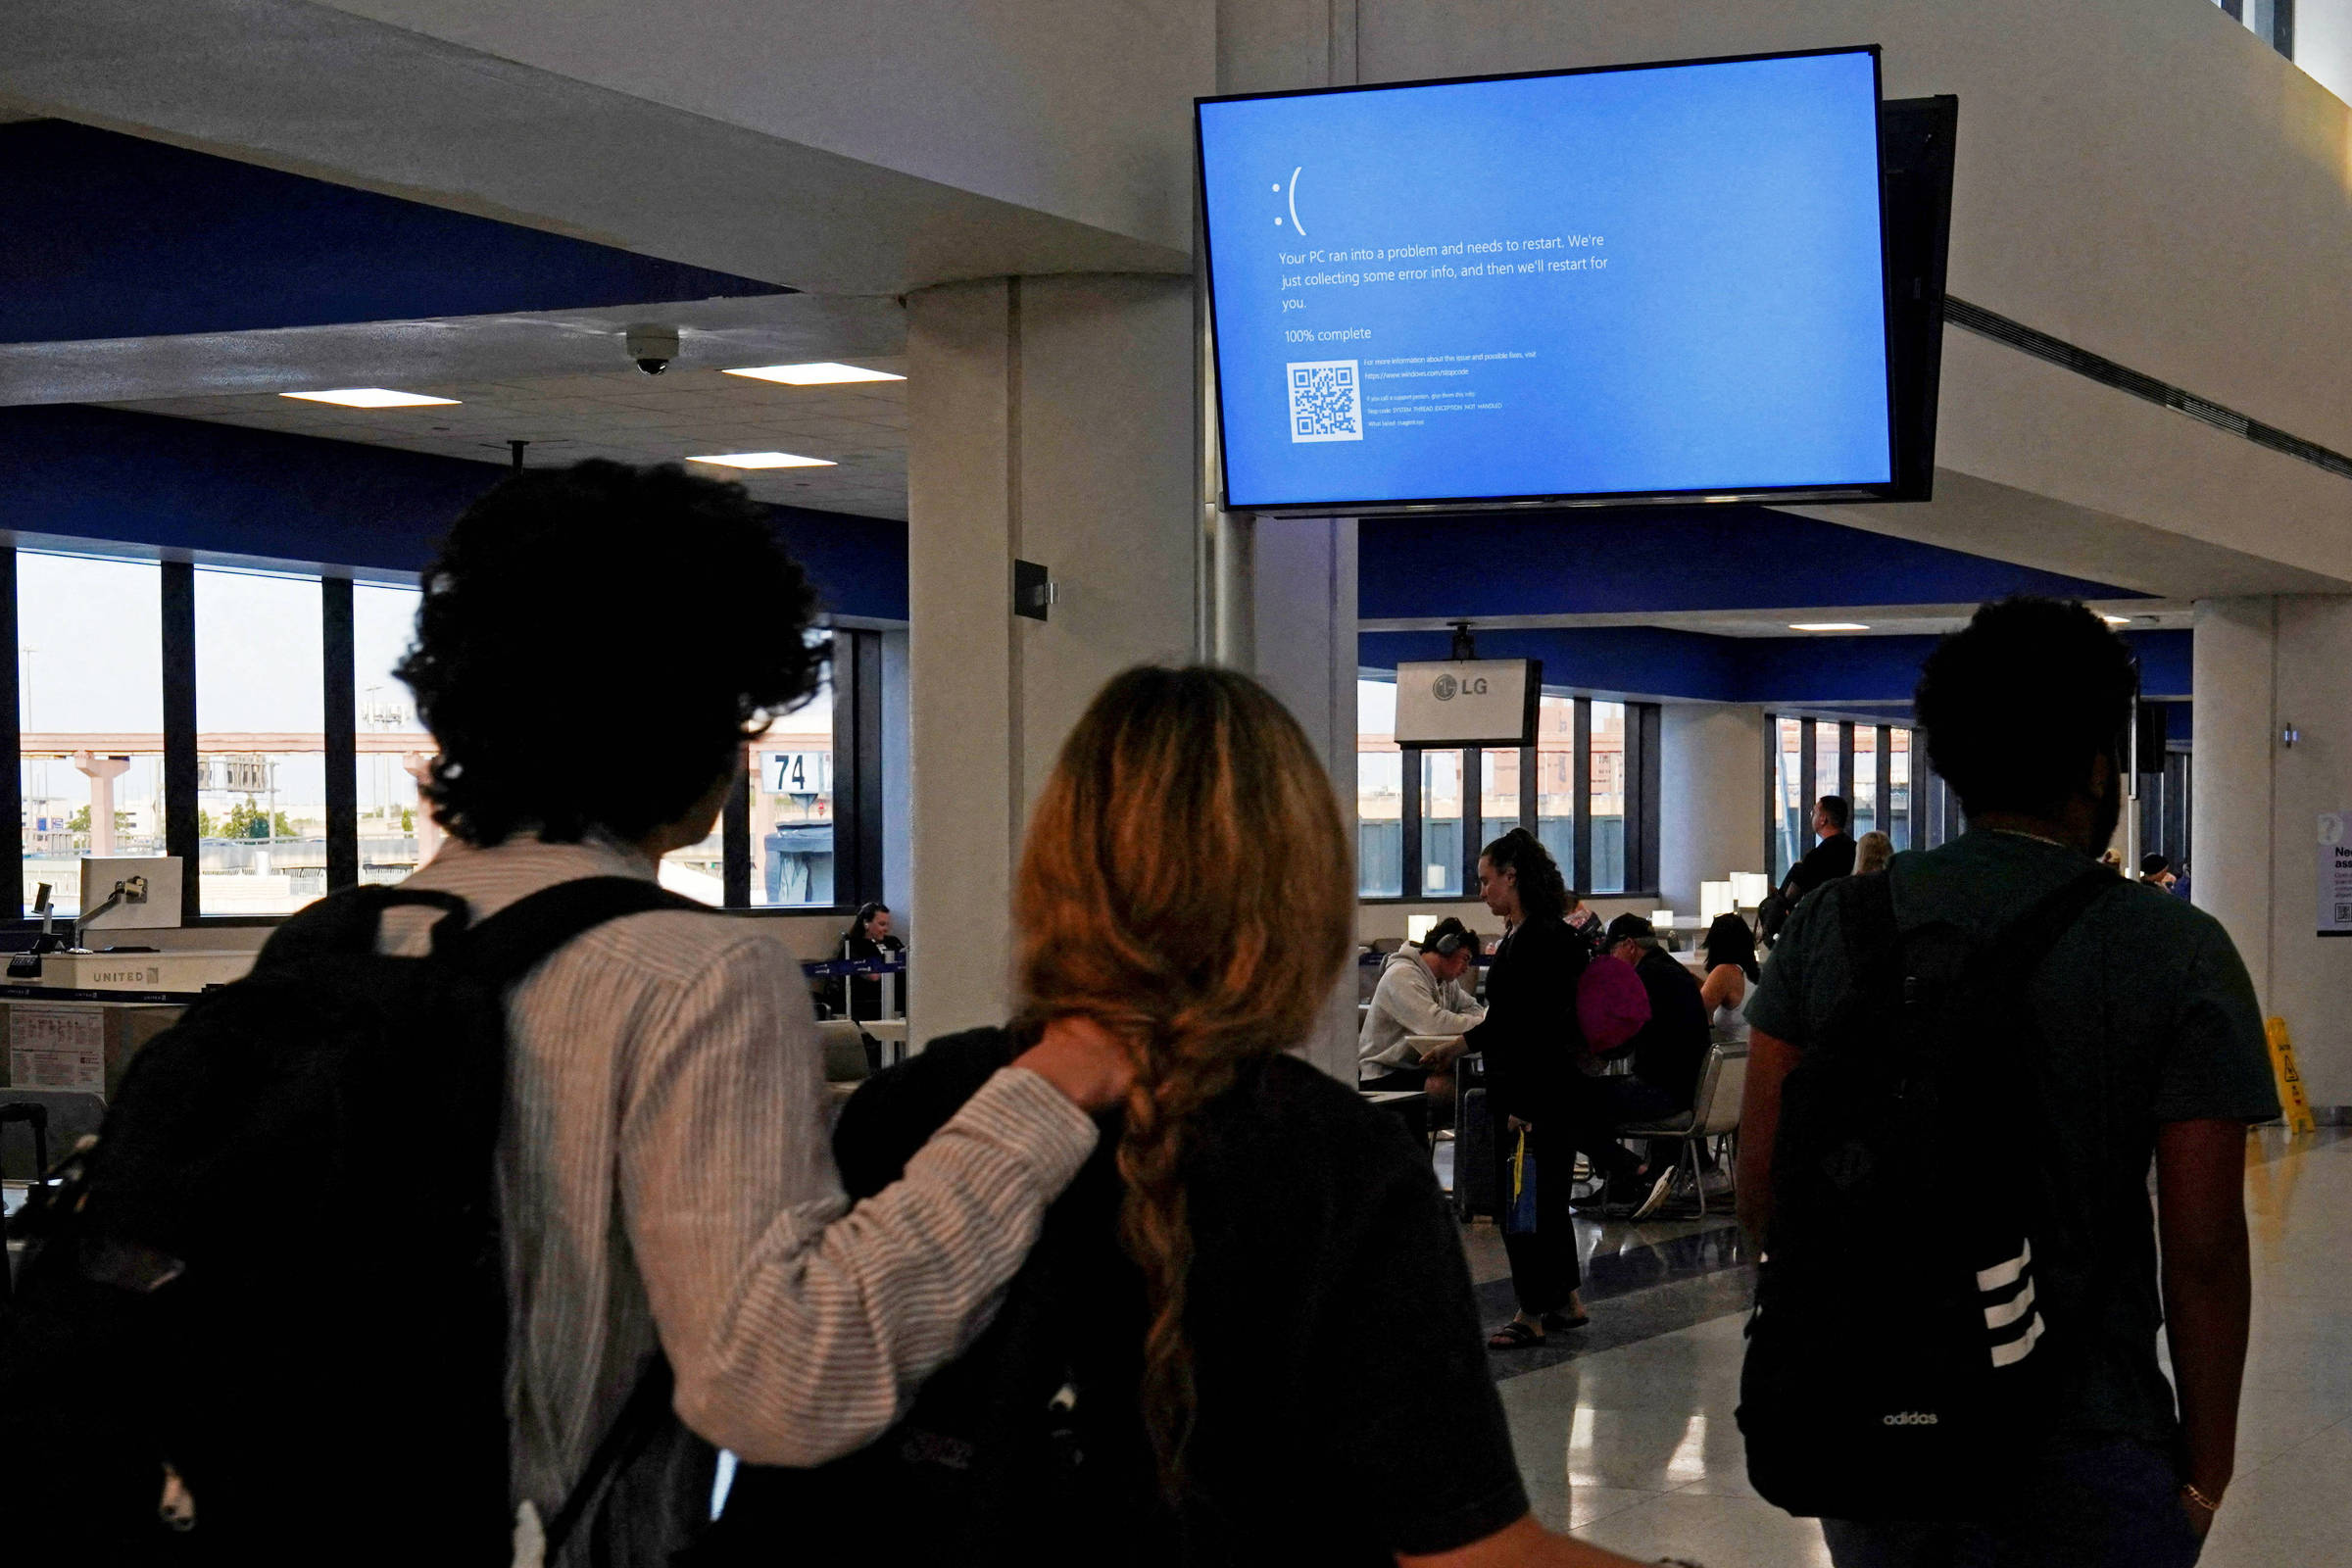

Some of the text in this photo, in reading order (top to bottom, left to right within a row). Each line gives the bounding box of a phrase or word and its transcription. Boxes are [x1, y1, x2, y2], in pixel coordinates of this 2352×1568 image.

[1279, 234, 1604, 265] Your PC ran into a problem and needs to restart. We're
[1281, 256, 1608, 290] just collecting some error info, and then we'll restart for
[1282, 298, 1307, 314] you.
[1285, 326, 1372, 343] 100% complete
[1462, 677, 1488, 695] LG
[775, 755, 805, 790] 74
[2335, 846, 2352, 858] Ne
[93, 971, 144, 982] UNITED
[1883, 1411, 1938, 1425] adidas
